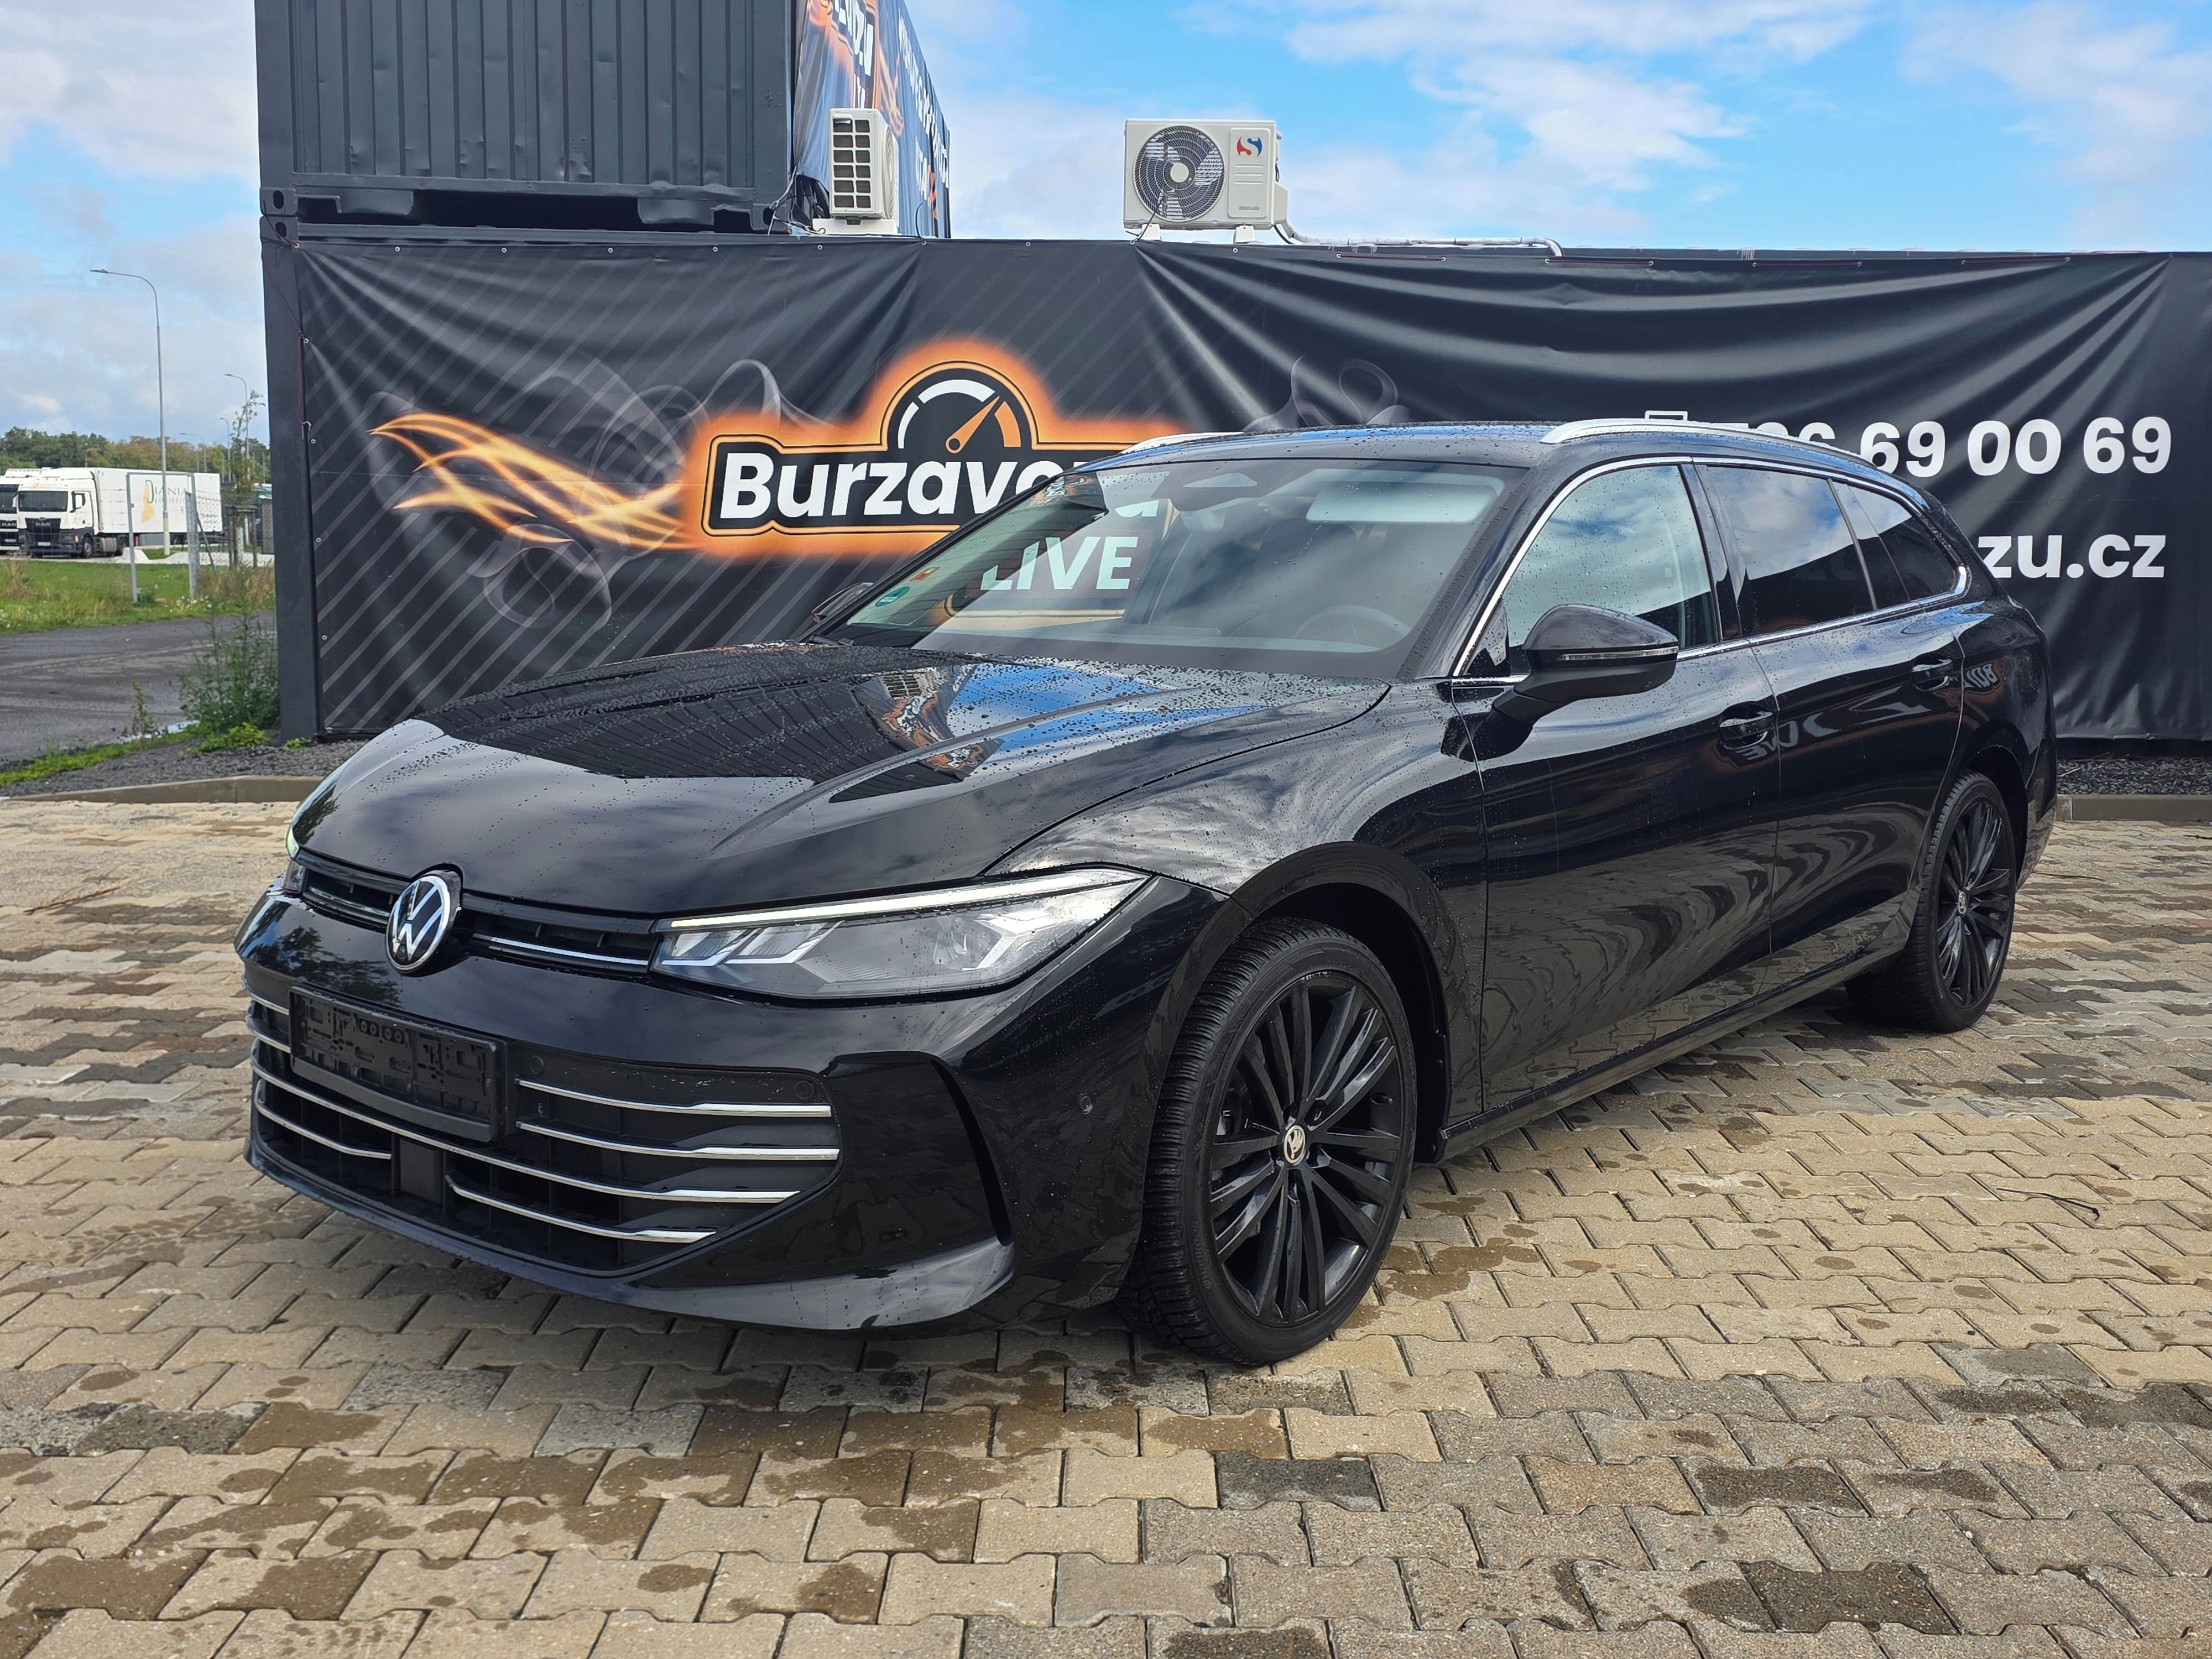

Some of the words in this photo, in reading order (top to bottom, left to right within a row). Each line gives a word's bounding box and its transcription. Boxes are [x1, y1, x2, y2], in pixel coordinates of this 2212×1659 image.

[1860, 421, 1946, 478] 69
[1967, 419, 2062, 476] 00
[2083, 416, 2172, 474] 69
[720, 452, 1159, 519] Burzavo
[980, 536, 1139, 591] LIVE
